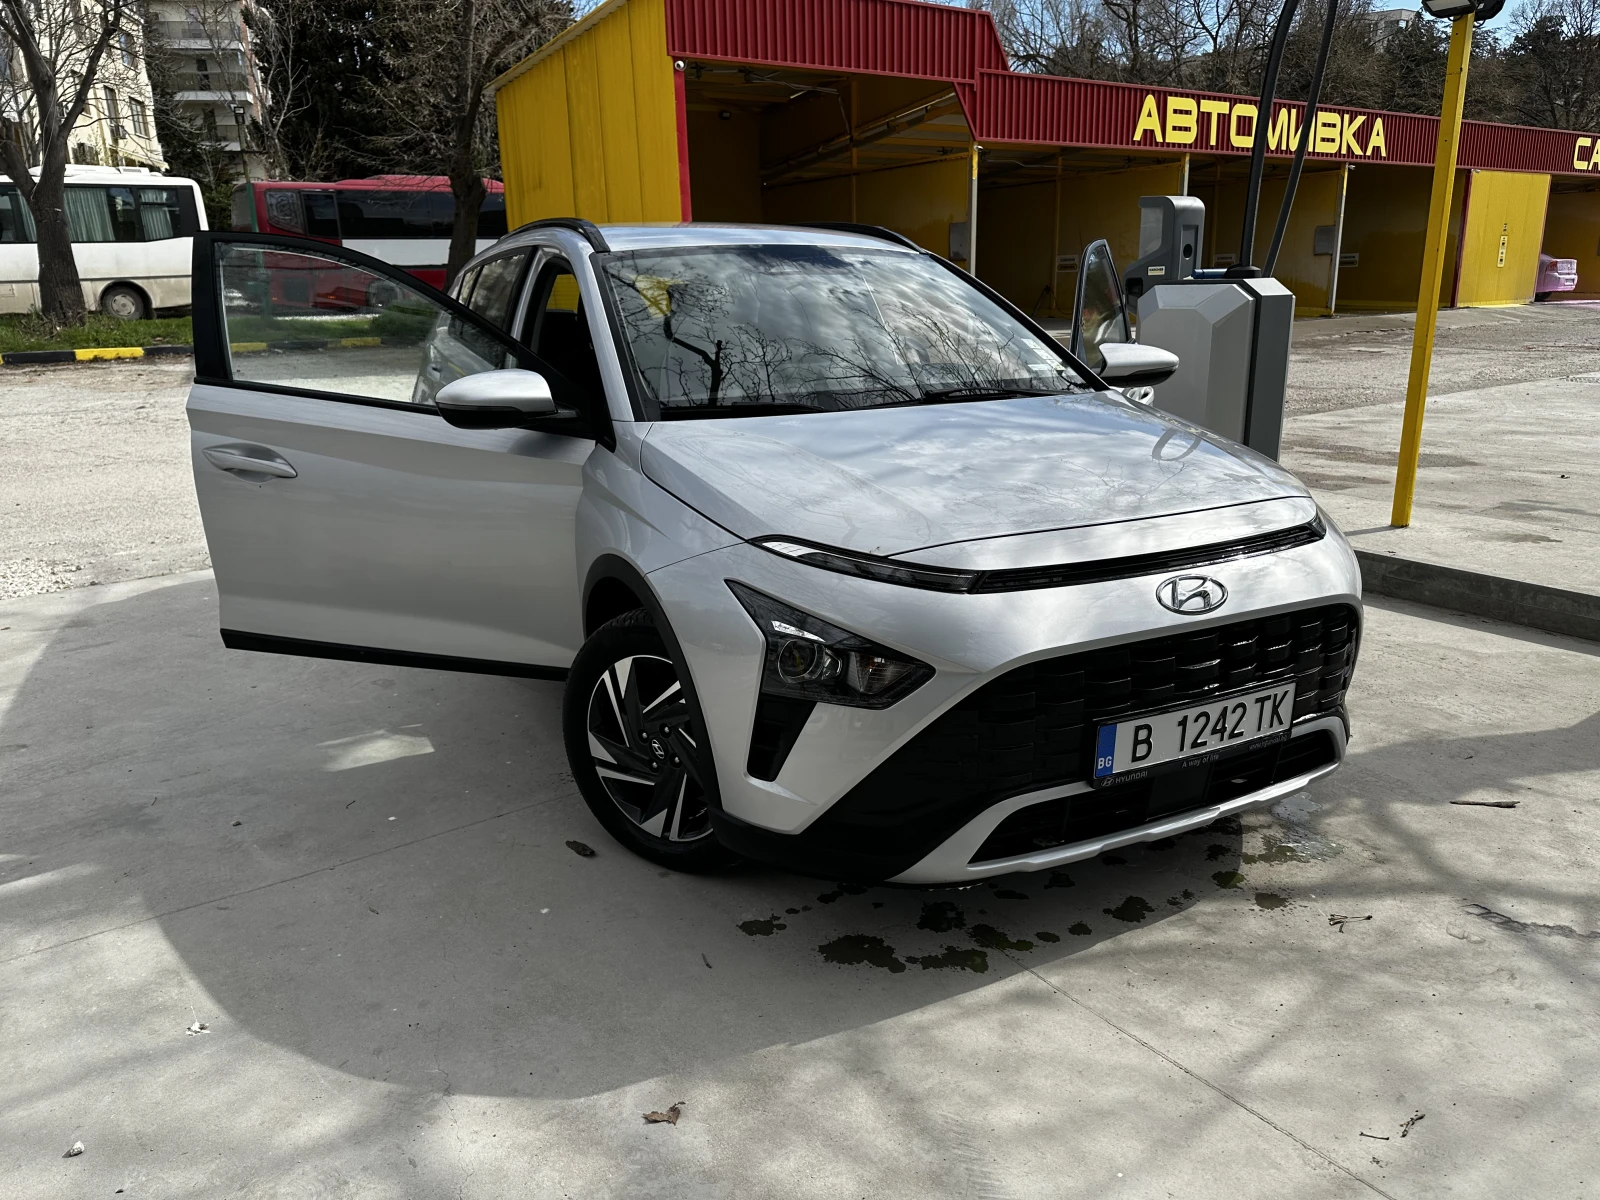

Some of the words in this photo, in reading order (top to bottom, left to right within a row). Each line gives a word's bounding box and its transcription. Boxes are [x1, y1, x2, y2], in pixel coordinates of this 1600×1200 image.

[1133, 94, 1387, 157] АВТОМИВКА
[1130, 723, 1154, 763] B
[1177, 702, 1248, 752] 1242
[1254, 689, 1290, 732] TK
[1097, 755, 1113, 770] BG
[1181, 760, 1188, 769] A
[1188, 758, 1202, 767] way
[1115, 770, 1148, 784] HYUNDAI
